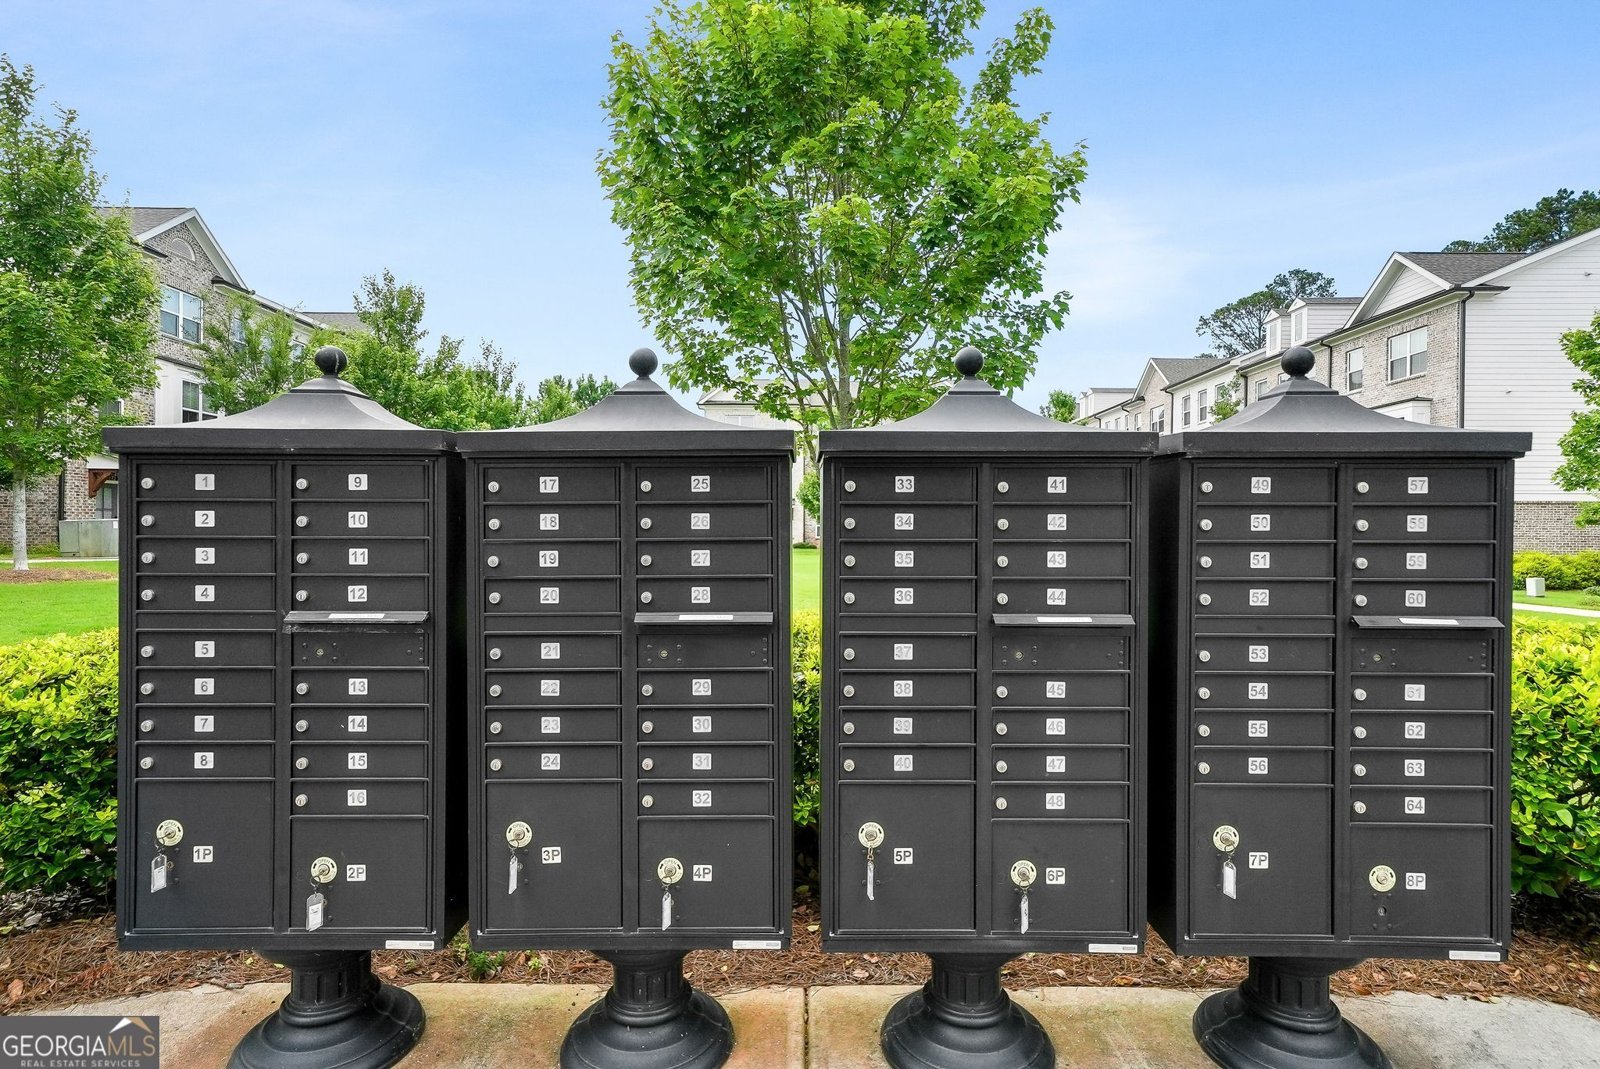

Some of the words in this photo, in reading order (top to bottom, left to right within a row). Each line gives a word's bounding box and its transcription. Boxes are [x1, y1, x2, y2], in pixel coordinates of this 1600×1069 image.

[202, 475, 208, 488] 1
[354, 476, 362, 488] 9
[541, 478, 557, 491] 17
[692, 478, 709, 490] 25
[897, 478, 913, 490] 33
[1049, 478, 1065, 491] 41
[1252, 479, 1270, 491] 49
[1409, 479, 1427, 492] 57
[201, 513, 209, 525] 2
[350, 513, 366, 526] 10
[542, 516, 557, 528] 18
[692, 515, 709, 528] 26
[896, 515, 912, 528] 34
[1049, 516, 1065, 528] 42
[1252, 516, 1268, 529] 50
[201, 549, 209, 562] 3
[351, 550, 366, 563] 11
[541, 552, 557, 565] 19
[692, 552, 709, 565] 27
[896, 552, 912, 565] 35
[1048, 552, 1065, 566] 43
[1252, 554, 1268, 566] 51
[1408, 555, 1424, 567] 59
[200, 587, 210, 599] 4
[349, 587, 366, 600] 12
[541, 589, 558, 602] 20
[693, 588, 709, 601] 28
[896, 589, 912, 602] 36
[1048, 590, 1065, 603] 44
[1251, 591, 1268, 604] 52
[1407, 592, 1424, 605] 60
[201, 643, 209, 656] 5
[543, 645, 559, 657] 21
[895, 645, 912, 658] 37
[1250, 647, 1267, 660] 53
[200, 680, 209, 693] 6
[350, 680, 366, 693] 13
[542, 682, 559, 694] 22
[693, 680, 710, 693] 29
[895, 682, 912, 695] 38
[1048, 683, 1064, 696] 45
[1250, 685, 1267, 697] 54
[200, 717, 209, 729] 7
[349, 717, 366, 730] 14
[543, 719, 559, 731] 23
[694, 718, 710, 730] 30
[895, 719, 910, 732] 39
[1047, 720, 1064, 733] 46
[1250, 722, 1267, 735] 55
[1406, 724, 1424, 737] 62
[200, 754, 208, 767] 8
[350, 755, 366, 767] 15
[542, 755, 559, 768] 24
[695, 755, 710, 768] 31
[895, 756, 912, 769] 40
[1047, 758, 1064, 770] 47
[1250, 759, 1267, 772] 56
[1406, 762, 1423, 774] 63
[349, 791, 365, 804] 16
[694, 792, 710, 805] 32
[1047, 795, 1064, 808] 48
[1406, 799, 1424, 812] 64
[194, 848, 212, 860] 1P
[543, 849, 560, 862] 3P
[895, 850, 912, 862] 5P
[1250, 854, 1267, 867] 7P
[348, 867, 365, 879] 2P
[694, 867, 711, 879] 4P
[1047, 869, 1064, 882] 6P
[1407, 875, 1425, 888] 8P
